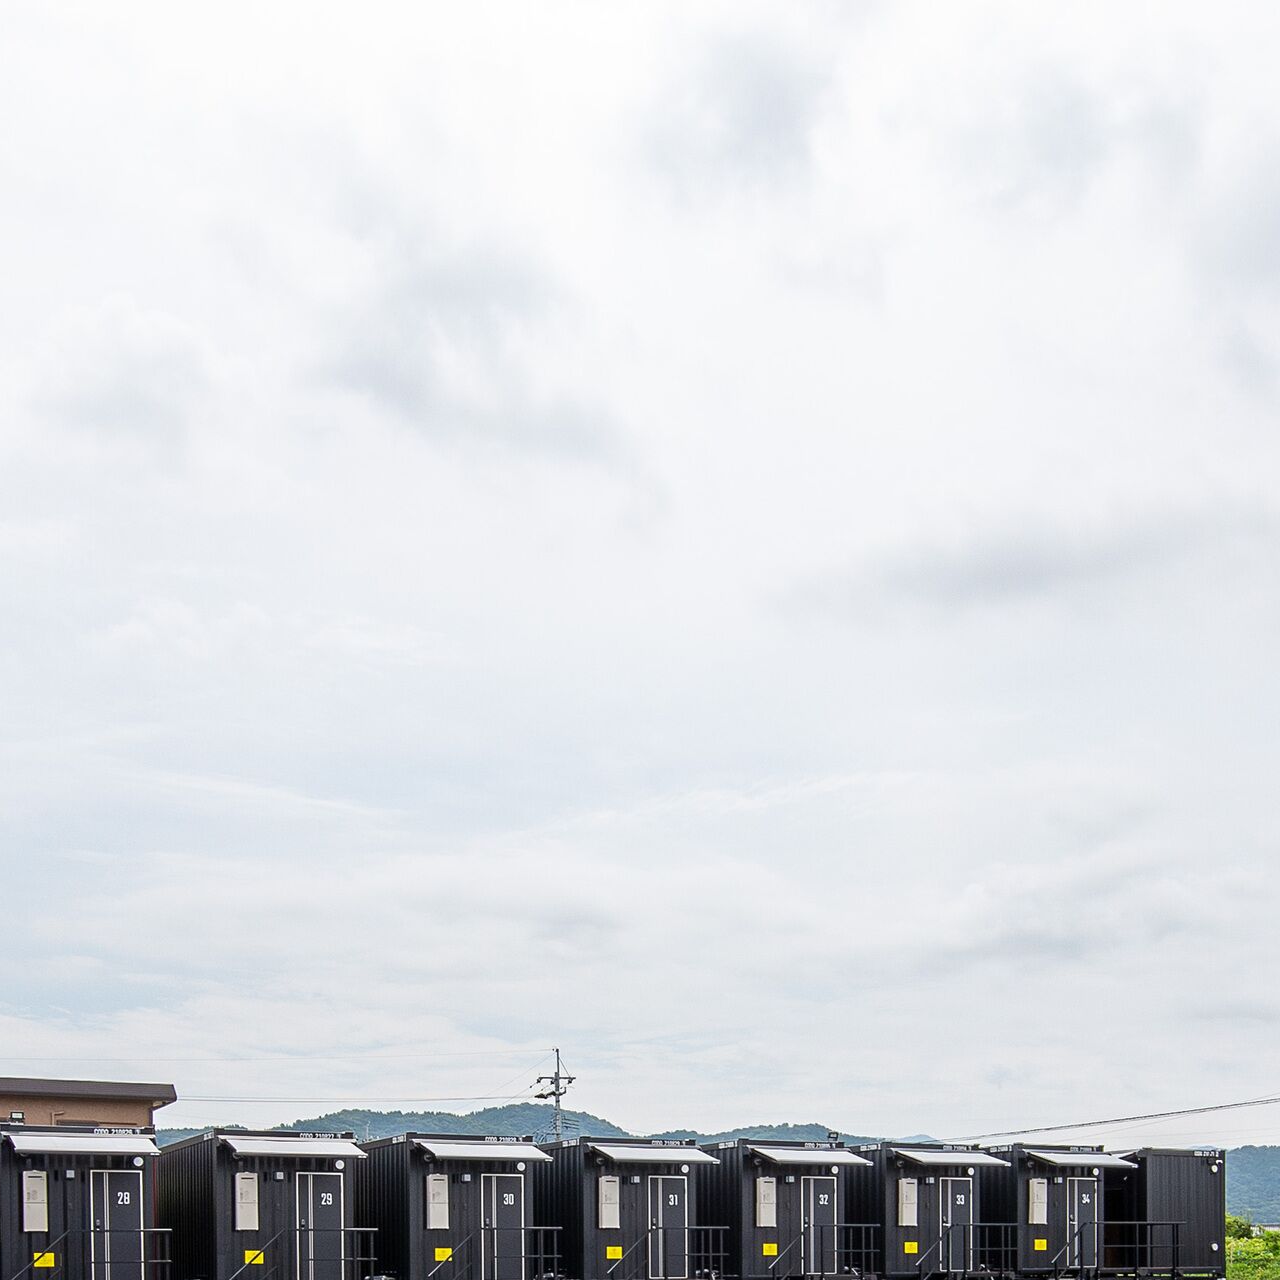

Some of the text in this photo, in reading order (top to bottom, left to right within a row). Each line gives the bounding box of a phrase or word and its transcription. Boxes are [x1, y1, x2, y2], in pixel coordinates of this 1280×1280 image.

[117, 1191, 131, 1205] 28
[320, 1192, 333, 1206] 29
[503, 1193, 515, 1206] 30
[668, 1194, 679, 1206] 31
[819, 1194, 829, 1205] 32
[956, 1194, 965, 1205] 33
